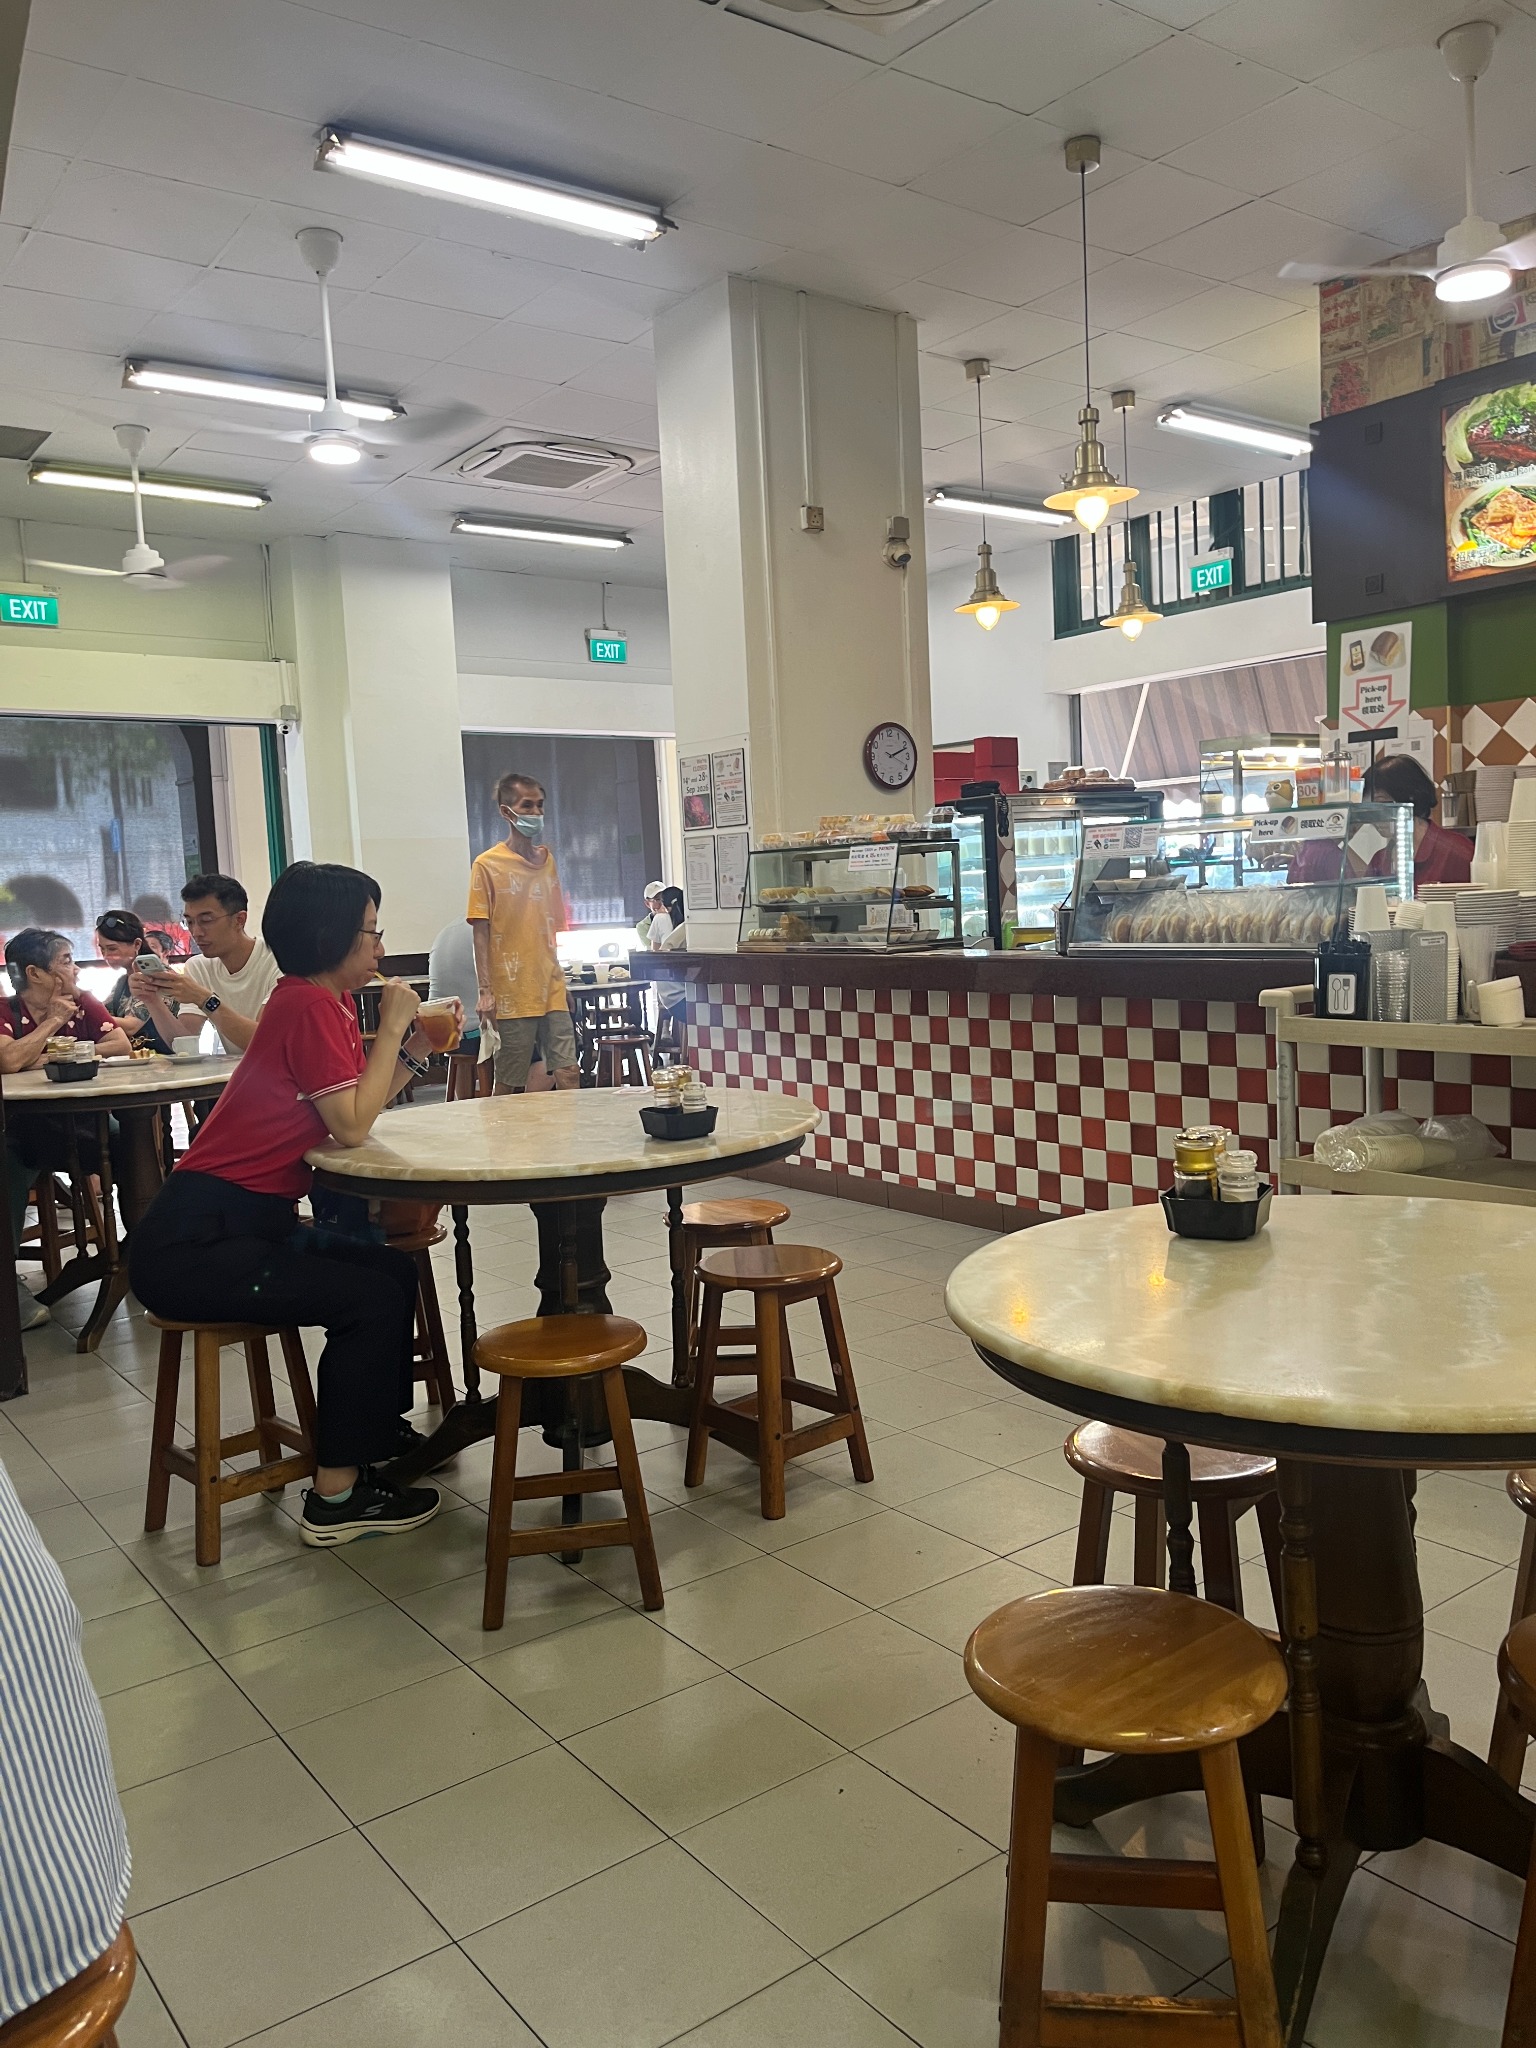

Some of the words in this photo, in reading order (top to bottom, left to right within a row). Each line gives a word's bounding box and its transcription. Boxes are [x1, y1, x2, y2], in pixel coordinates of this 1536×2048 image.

[1196, 565, 1224, 588] EXIT
[9, 599, 48, 620] EXIT
[596, 642, 621, 659] EXIT
[1360, 684, 1387, 695] Pick-up
[1365, 695, 1382, 703] here
[1362, 704, 1385, 715] 领取处
[878, 732, 884, 741] 11
[886, 729, 893, 738] 12
[902, 741, 908, 749] 2
[871, 752, 876, 760] 9
[873, 764, 879, 772] 8
[903, 764, 908, 772] 4
[889, 775, 894, 784] 6
[898, 772, 903, 780] 5
[686, 786, 696, 795] Sep
[1298, 785, 1317, 797] 30¢
[1254, 818, 1279, 828] Pick-up
